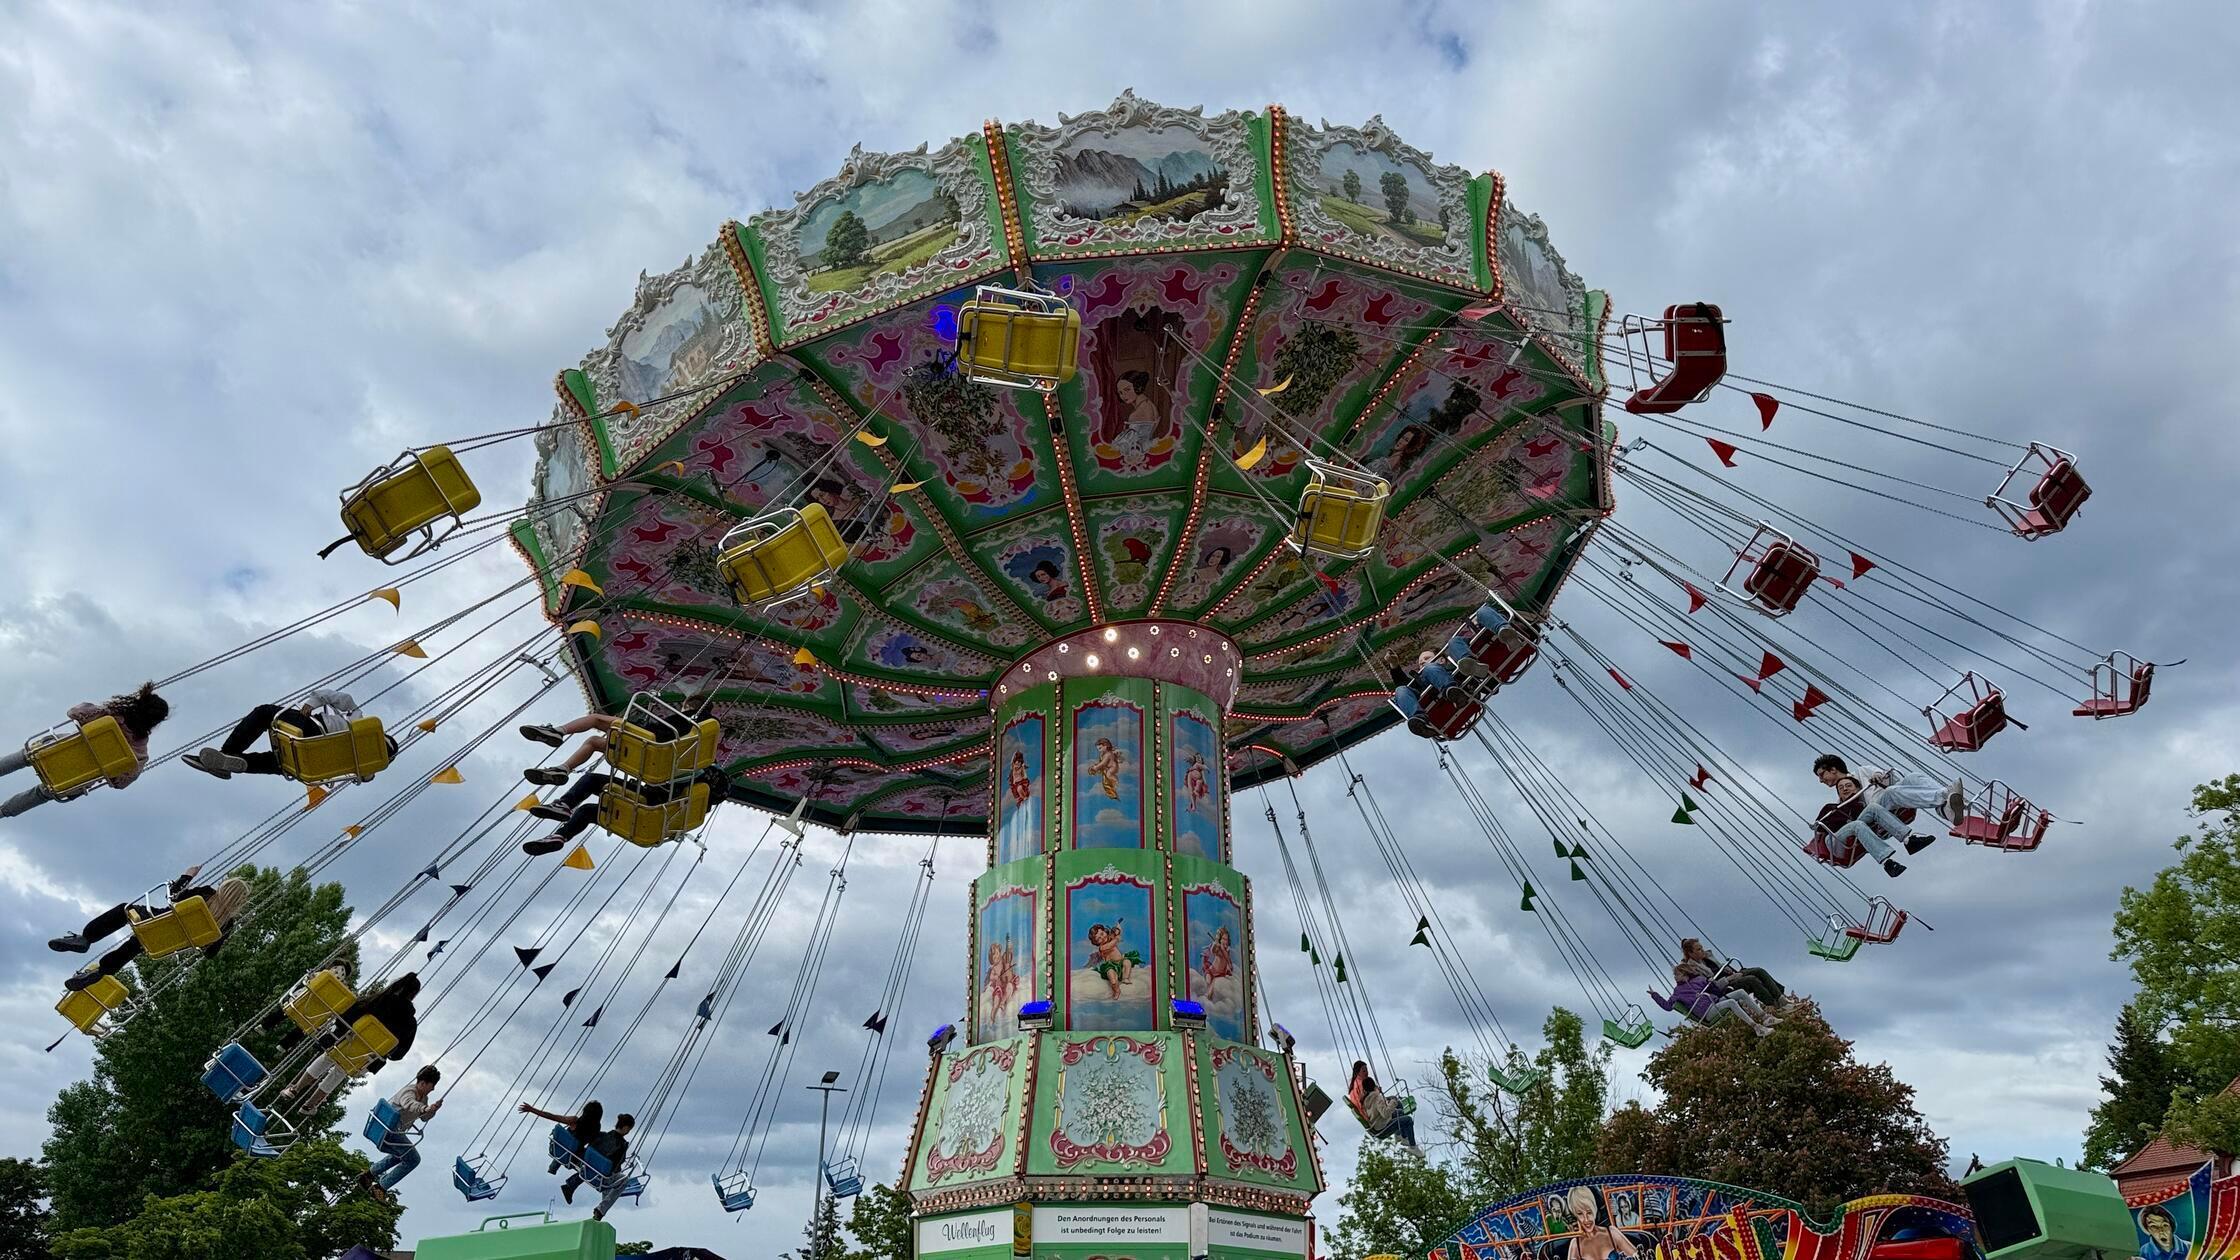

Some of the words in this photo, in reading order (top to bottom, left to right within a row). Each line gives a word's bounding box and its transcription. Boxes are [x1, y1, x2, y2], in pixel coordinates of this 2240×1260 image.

[1073, 1215, 1118, 1224] Anordnungen
[941, 1219, 995, 1242] Wellenflug
[1070, 1227, 1105, 1236] unbedingt
[1107, 1227, 1125, 1235] Folge
